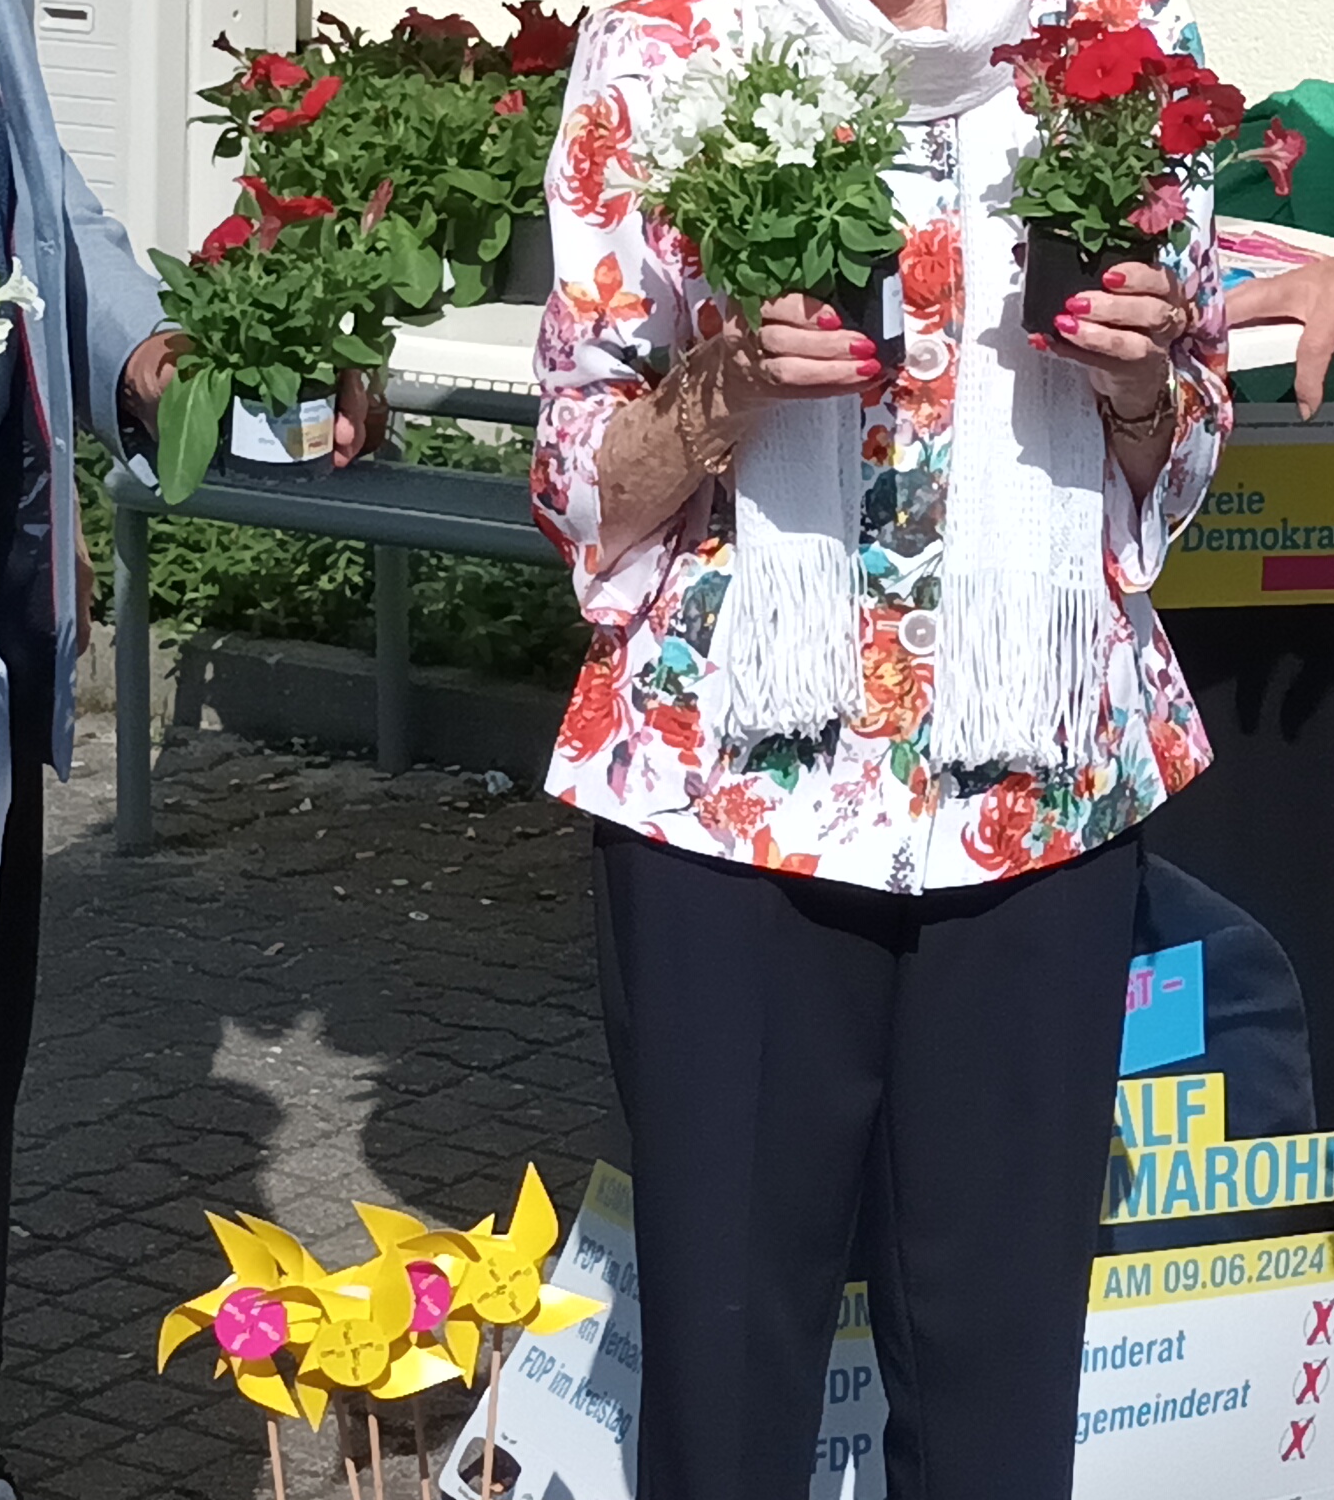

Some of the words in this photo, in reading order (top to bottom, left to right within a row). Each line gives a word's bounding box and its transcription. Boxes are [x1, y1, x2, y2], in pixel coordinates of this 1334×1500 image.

[1199, 482, 1266, 516] reie
[1116, 1078, 1206, 1149] ALF
[1103, 1263, 1152, 1300] AM
[1163, 1242, 1326, 1294] 09.06.2024
[518, 1345, 557, 1381] FDP
[549, 1363, 574, 1401] im
[569, 1379, 633, 1445] Kreistag
[829, 1366, 873, 1405] DP
[1081, 1329, 1187, 1374] inderat
[1074, 1378, 1252, 1445] gemeinderat
